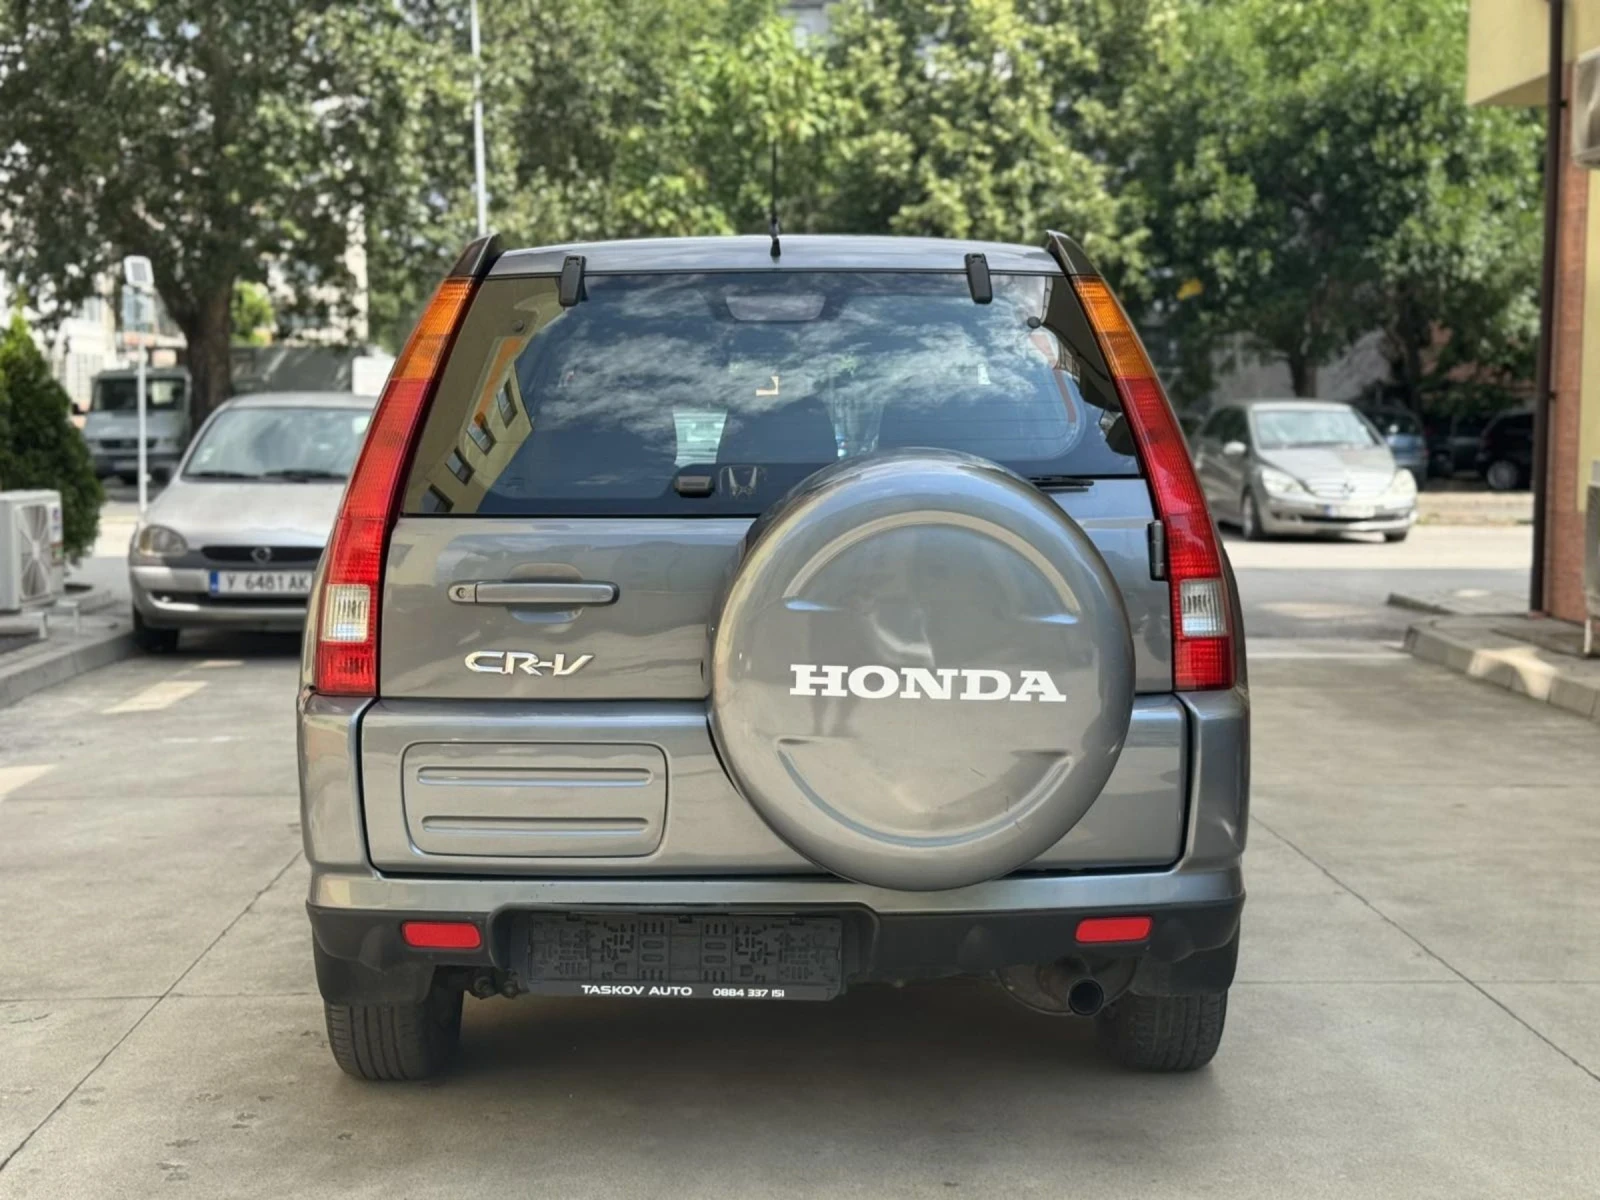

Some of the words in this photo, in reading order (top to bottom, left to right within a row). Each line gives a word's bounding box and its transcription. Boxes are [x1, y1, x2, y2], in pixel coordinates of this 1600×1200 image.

[289, 574, 309, 590] AK
[464, 650, 594, 677] CR-V
[789, 663, 1067, 702] HONDA
[581, 984, 645, 996] TASKOV
[648, 985, 693, 997] AUTO
[712, 987, 745, 998] 0884
[747, 988, 769, 998] 337
